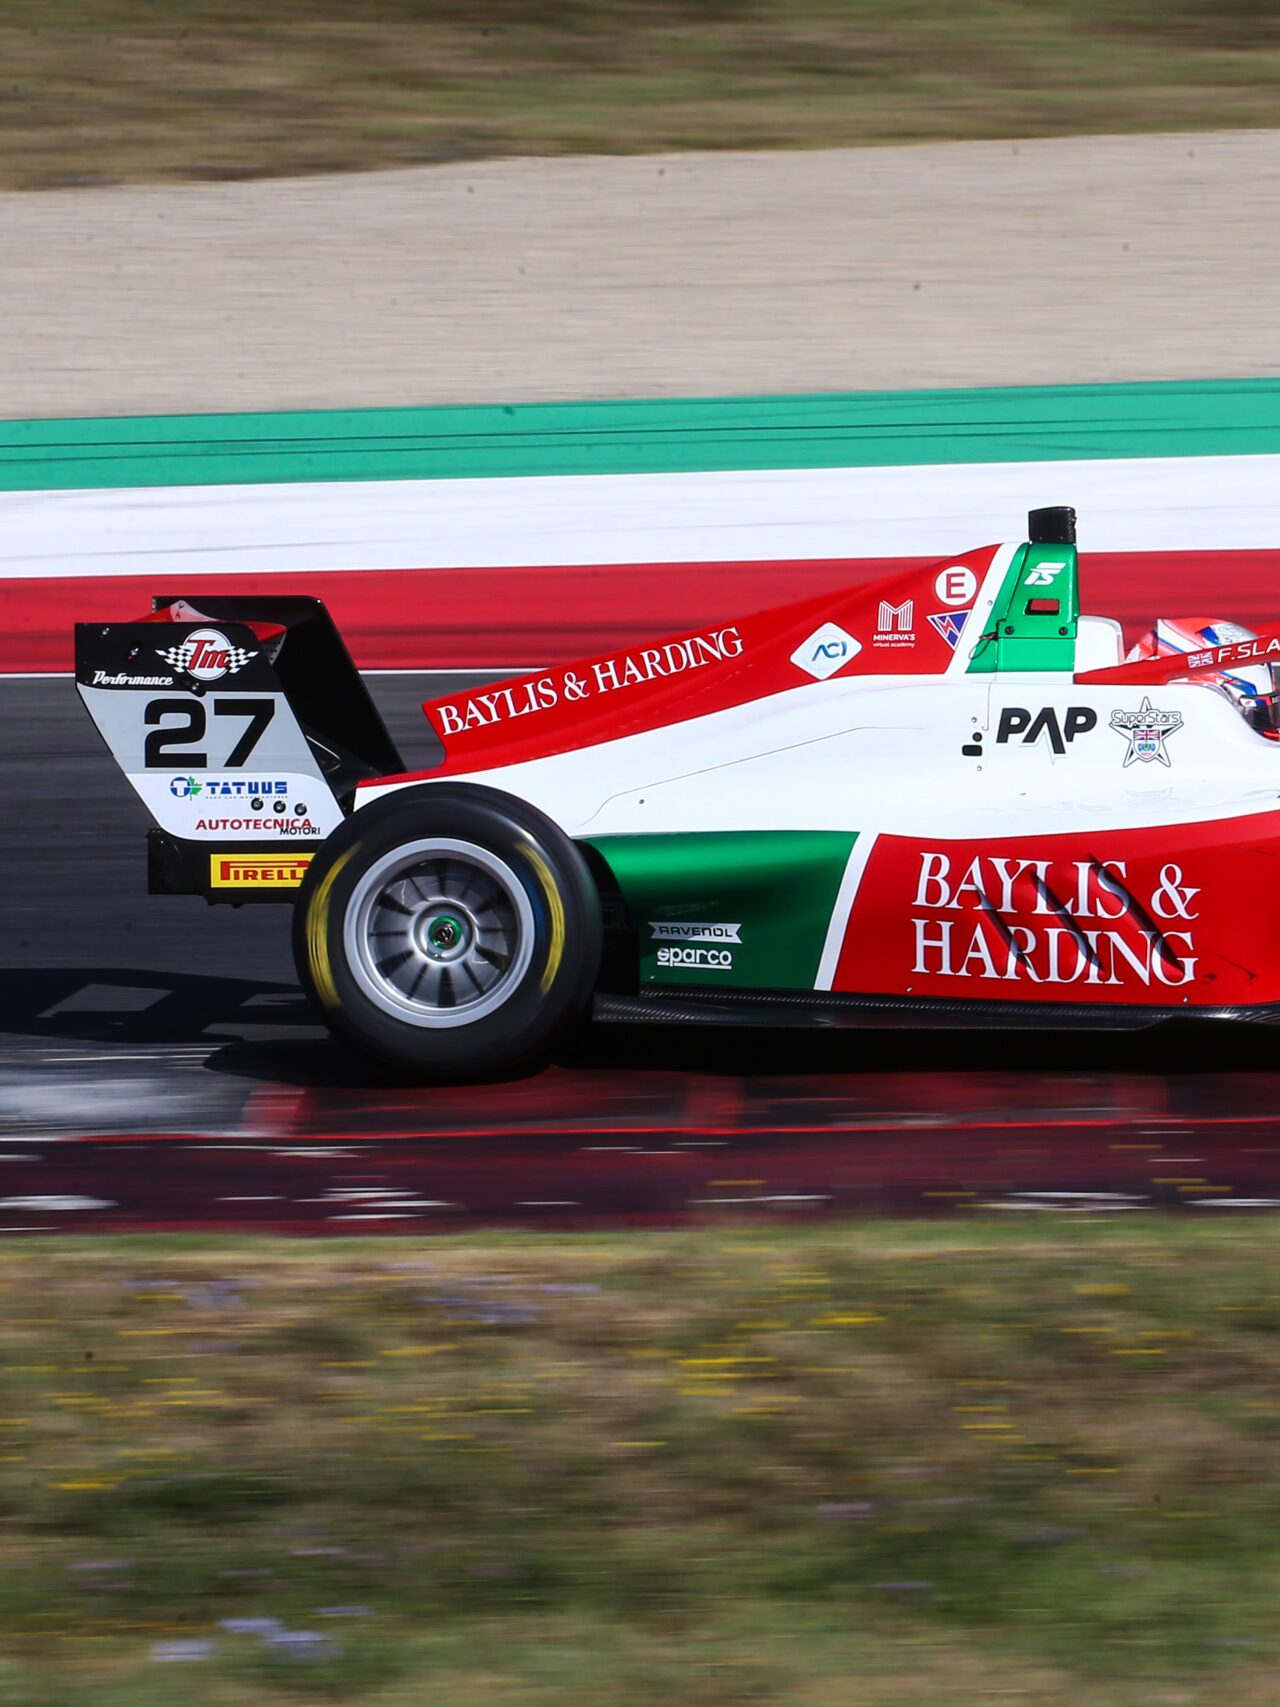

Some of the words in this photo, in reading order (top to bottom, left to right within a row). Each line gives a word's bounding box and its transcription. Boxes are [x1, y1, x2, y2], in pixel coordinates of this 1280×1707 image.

[946, 573, 967, 599] E
[873, 633, 915, 641] MINERVA'S
[811, 640, 847, 662] ACI
[92, 670, 174, 686] Performance
[437, 677, 558, 735] BAYLIS
[563, 671, 590, 701] &
[591, 627, 744, 693] HARDING
[1113, 711, 1180, 727] SuperStars
[144, 698, 275, 768] 27
[206, 781, 288, 795] TATUUS
[194, 818, 313, 830] AUTOTECNICA
[279, 827, 321, 836] MOTORI
[220, 860, 311, 881] PIRELL
[912, 852, 1128, 919] BAYLIS
[1151, 864, 1201, 920] &
[659, 926, 733, 938] RAVENOL
[657, 947, 732, 968] sparco
[911, 918, 1199, 986] HARDING
